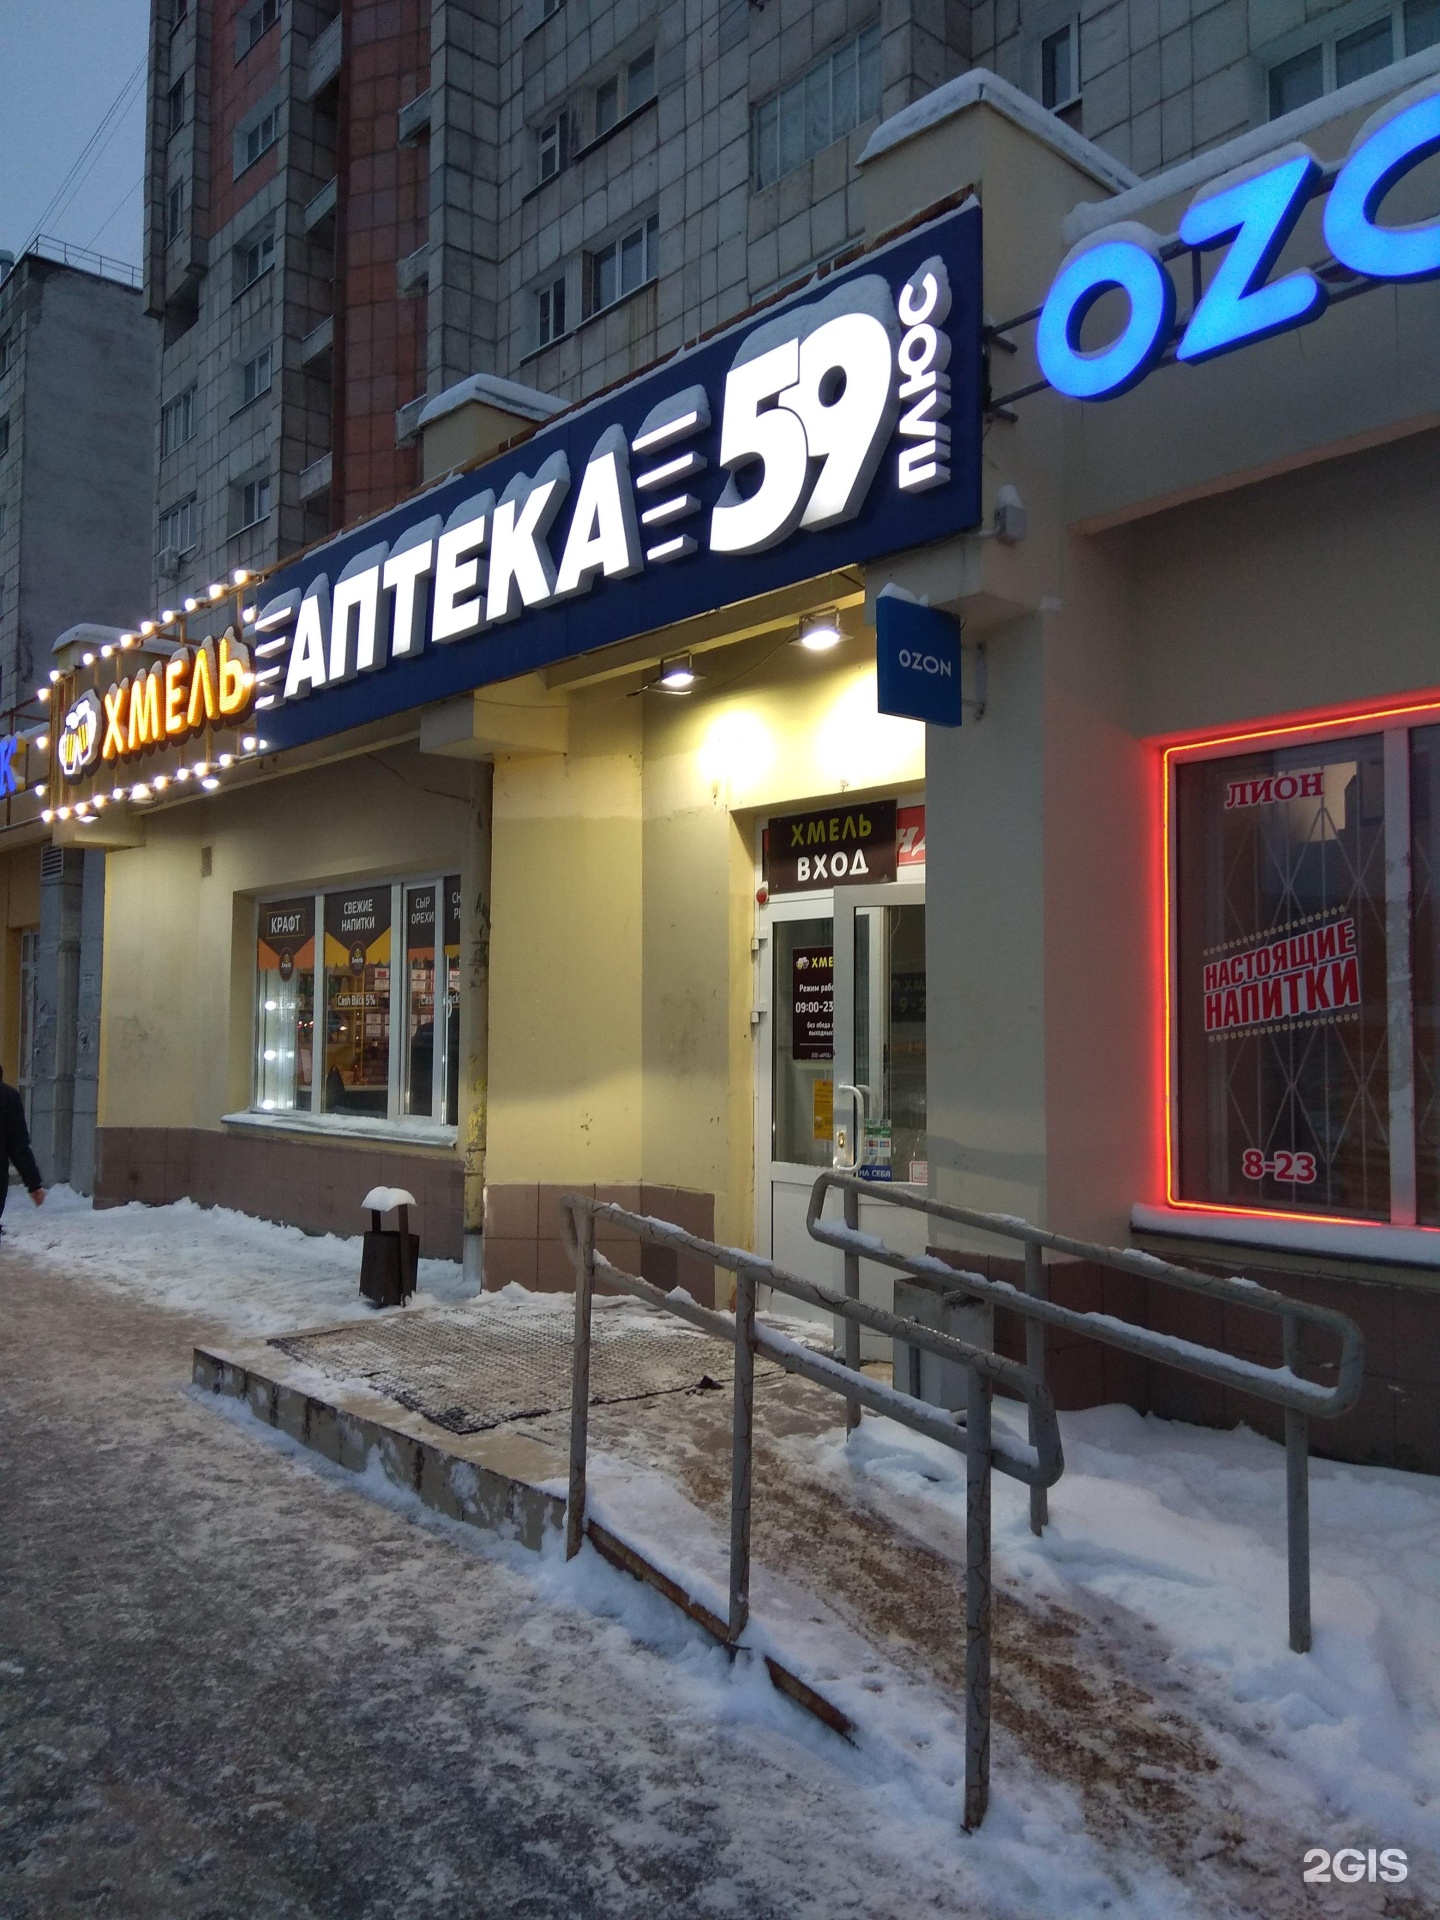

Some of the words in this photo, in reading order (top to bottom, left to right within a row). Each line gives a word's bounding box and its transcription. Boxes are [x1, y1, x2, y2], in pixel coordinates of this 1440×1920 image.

[898, 272, 938, 489] ПЛЮС
[283, 452, 632, 699] АПТЕКА
[710, 312, 892, 551] 59
[898, 649, 952, 677] OZON
[103, 637, 246, 760] ХМЕЛЬ
[1227, 772, 1324, 807] ЛИОН
[791, 813, 872, 847] ХМЕЛЬ
[797, 849, 869, 881] ВХОД
[343, 899, 373, 914] СВЕЖИЕ
[415, 896, 430, 909] СЫР
[271, 914, 301, 934] КРАФТ
[341, 916, 375, 932] НАПИТКИ
[411, 911, 434, 924] ОРЕХИ
[1205, 919, 1355, 991] НАСТОЯЩИЕ
[337, 995, 350, 1006] Cash
[365, 994, 376, 1005] 5%
[799, 983, 819, 993] Режим
[1206, 957, 1360, 1031] НАПИТКИ
[807, 1021, 815, 1029] без
[816, 1021, 831, 1029] обеда
[871, 1169, 891, 1178] СЕБЯ
[1244, 1150, 1315, 1182] 8-23
